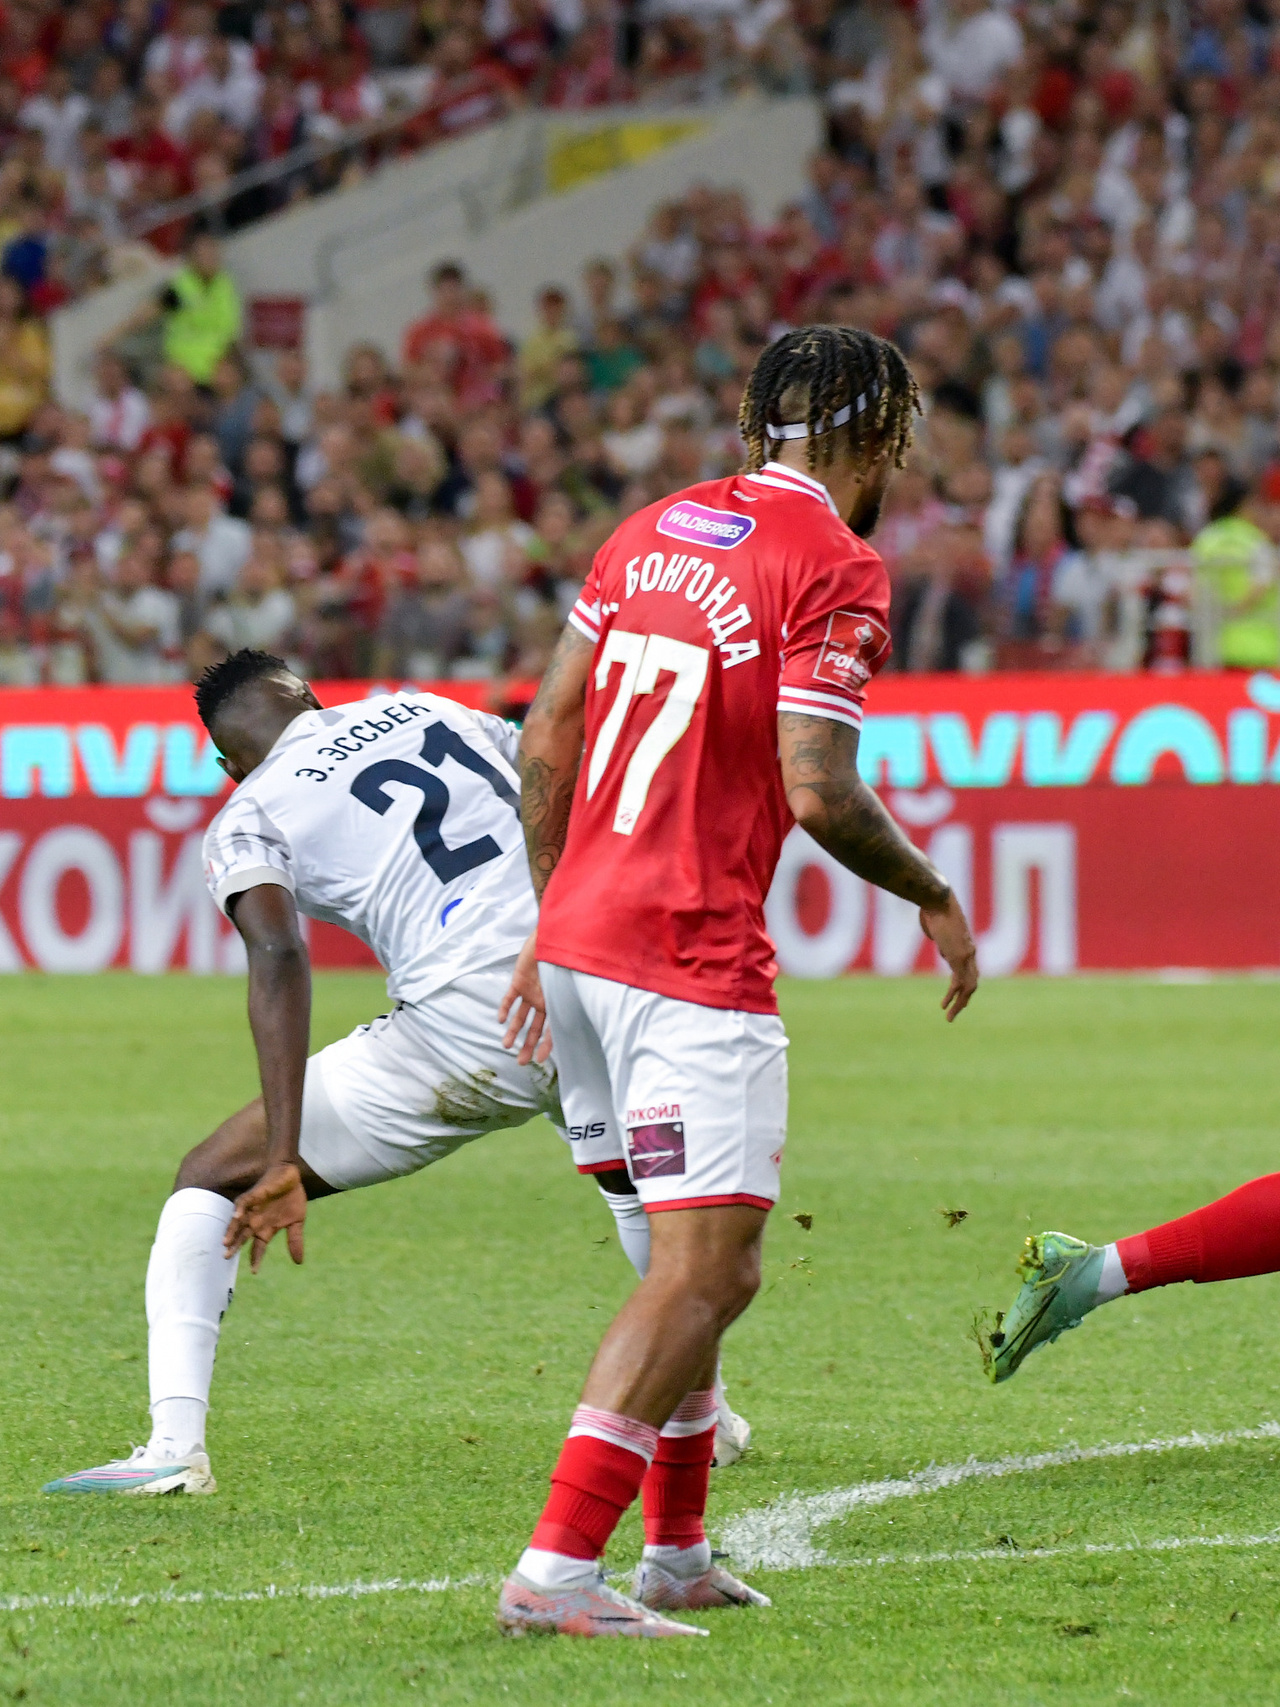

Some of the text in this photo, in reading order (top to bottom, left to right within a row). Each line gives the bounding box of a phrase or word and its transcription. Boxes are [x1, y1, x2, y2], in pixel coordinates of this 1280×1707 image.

[667, 509, 745, 540] WILDBERRIES
[625, 552, 761, 670] БОНГОНДА
[350, 720, 523, 886] 21
[586, 629, 710, 836] 77
